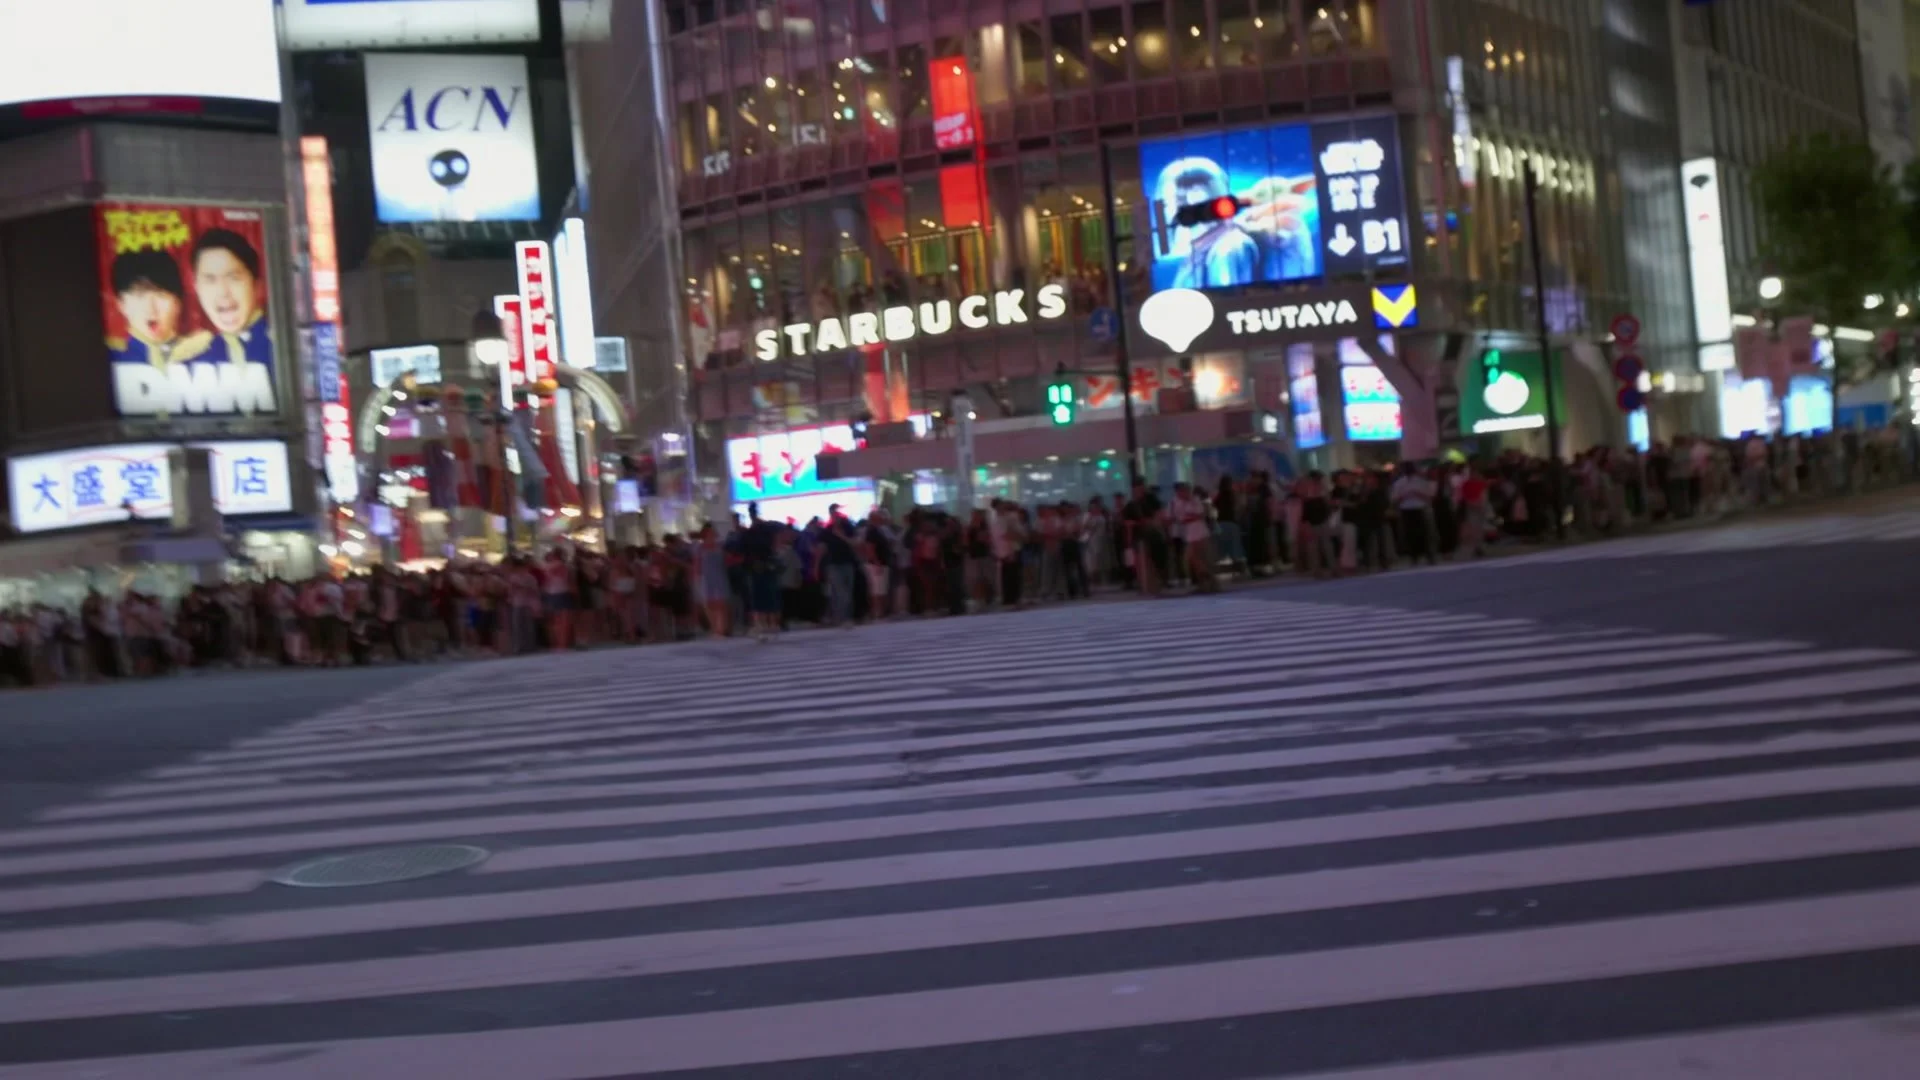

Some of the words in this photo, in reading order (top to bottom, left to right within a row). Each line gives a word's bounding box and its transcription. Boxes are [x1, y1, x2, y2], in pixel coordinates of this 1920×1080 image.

[376, 85, 524, 132] ACN
[1361, 217, 1401, 255] B1
[755, 284, 1067, 361] STARBUCKS
[1226, 299, 1358, 334] TSUTAYA
[113, 361, 278, 415] DMM
